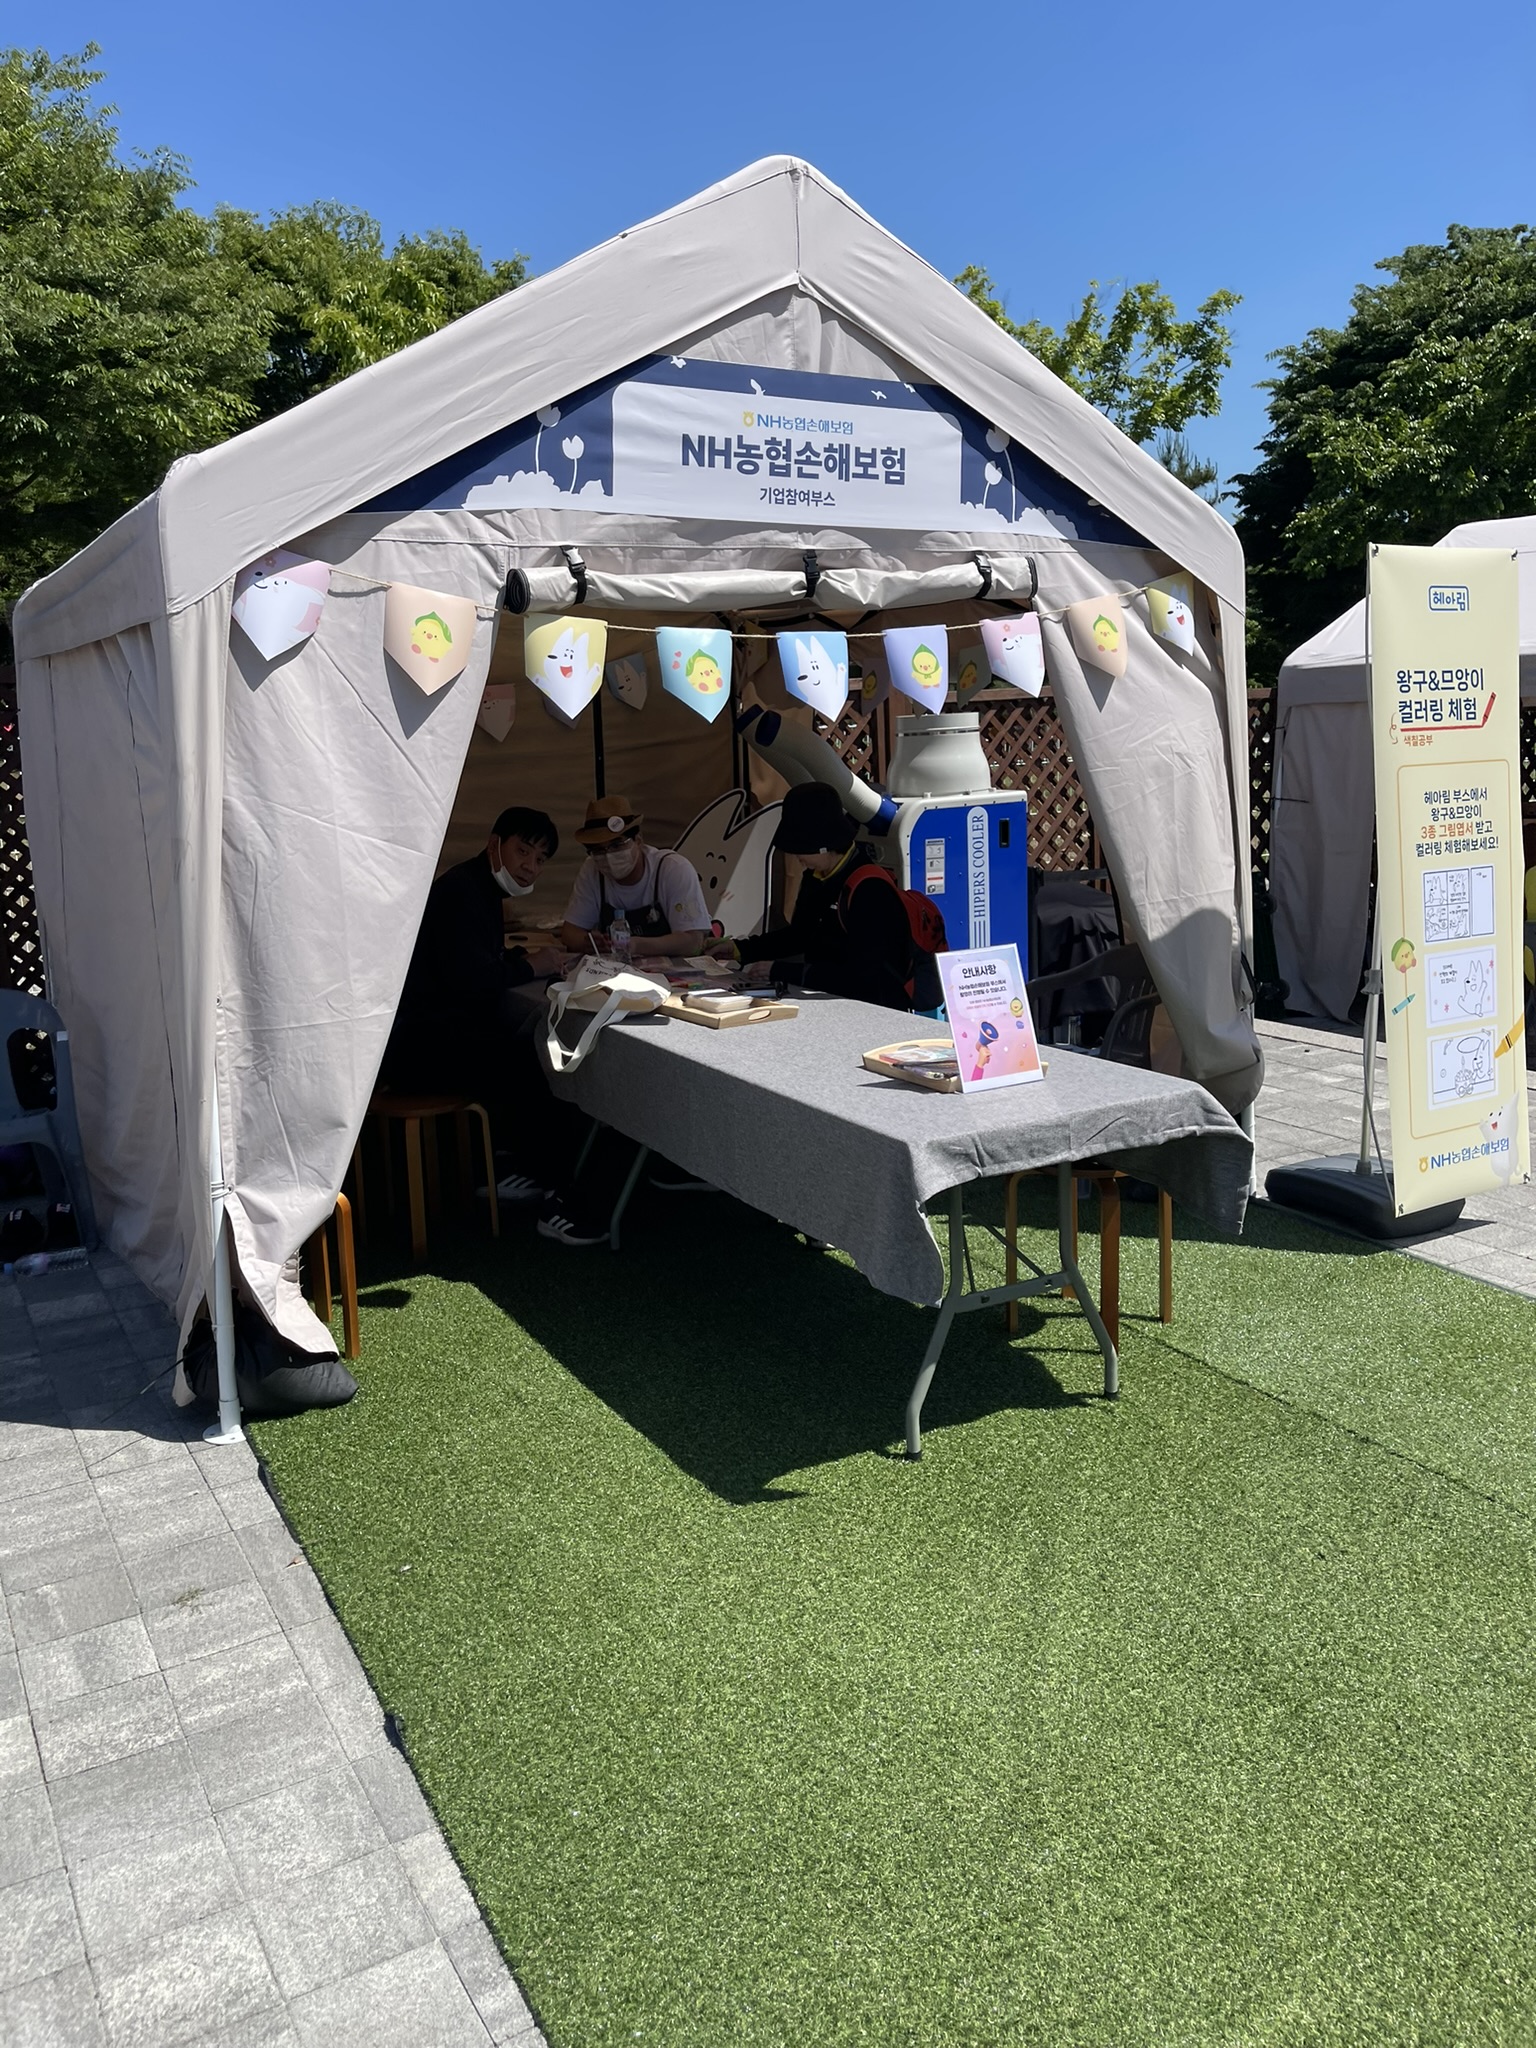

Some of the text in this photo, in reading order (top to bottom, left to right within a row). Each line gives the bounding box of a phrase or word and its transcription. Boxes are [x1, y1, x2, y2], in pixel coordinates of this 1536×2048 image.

[757, 413, 854, 435] NH농협손해보험
[681, 433, 906, 485] NH농협손해보험
[759, 487, 836, 507] 기업참여부스
[1432, 590, 1466, 611] 헤아림
[1396, 667, 1484, 693] 왕구&므앙이
[1398, 697, 1477, 723] 컬러링 체험
[1403, 734, 1433, 747] 색칠공부
[1423, 787, 1488, 805] 헤아림 부스에서
[1431, 804, 1482, 822] 왕구&므앙이
[1421, 820, 1493, 839] 3종 그림엽서 받고
[1415, 836, 1499, 858] 컬러링 체험해보세요!
[971, 814, 986, 918] HIPERS COOLER
[962, 964, 997, 979] 안내사항
[1430, 1138, 1510, 1170] NH농협손해보험
